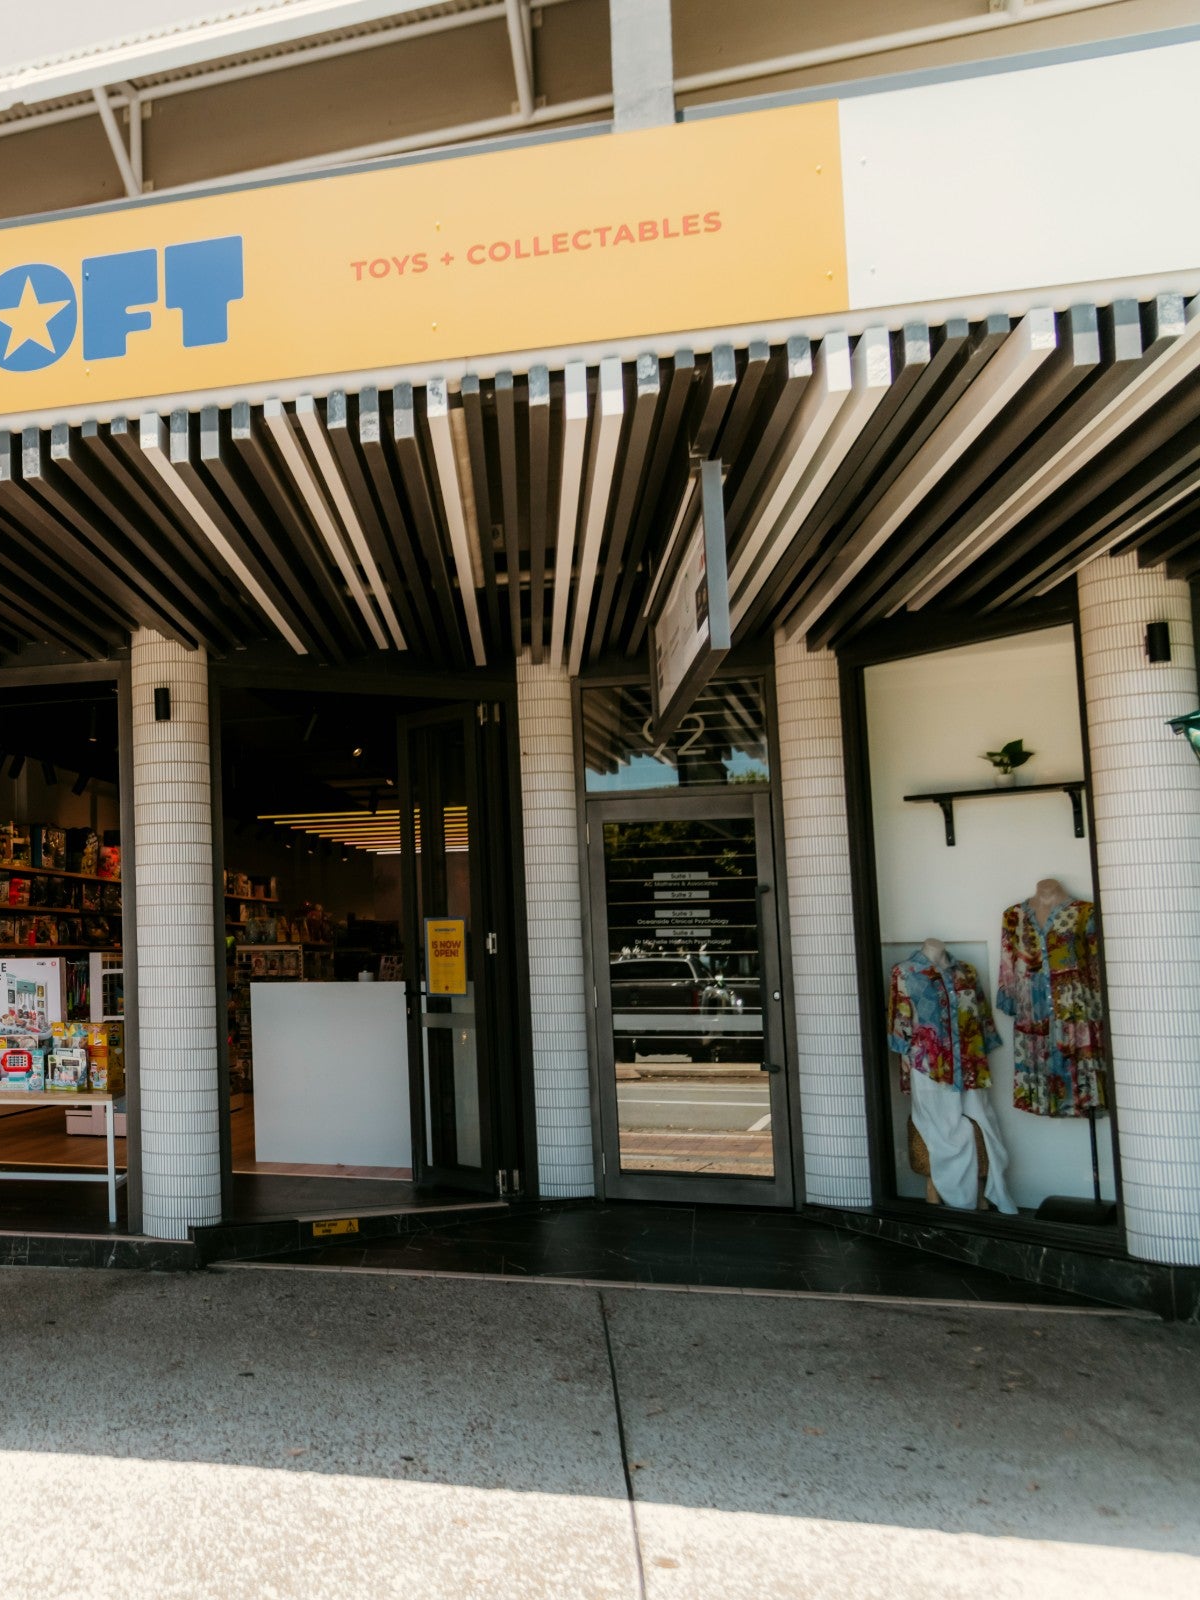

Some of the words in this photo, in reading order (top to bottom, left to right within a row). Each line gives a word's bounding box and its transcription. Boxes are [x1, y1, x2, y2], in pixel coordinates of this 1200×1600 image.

[350, 253, 429, 281] TOYS
[440, 251, 455, 266] +
[466, 211, 722, 266] COLLECTABLES
[694, 918, 729, 926] Psychology
[431, 940, 438, 949] IS
[439, 940, 462, 949] NOW
[434, 949, 459, 958] OPEN!
